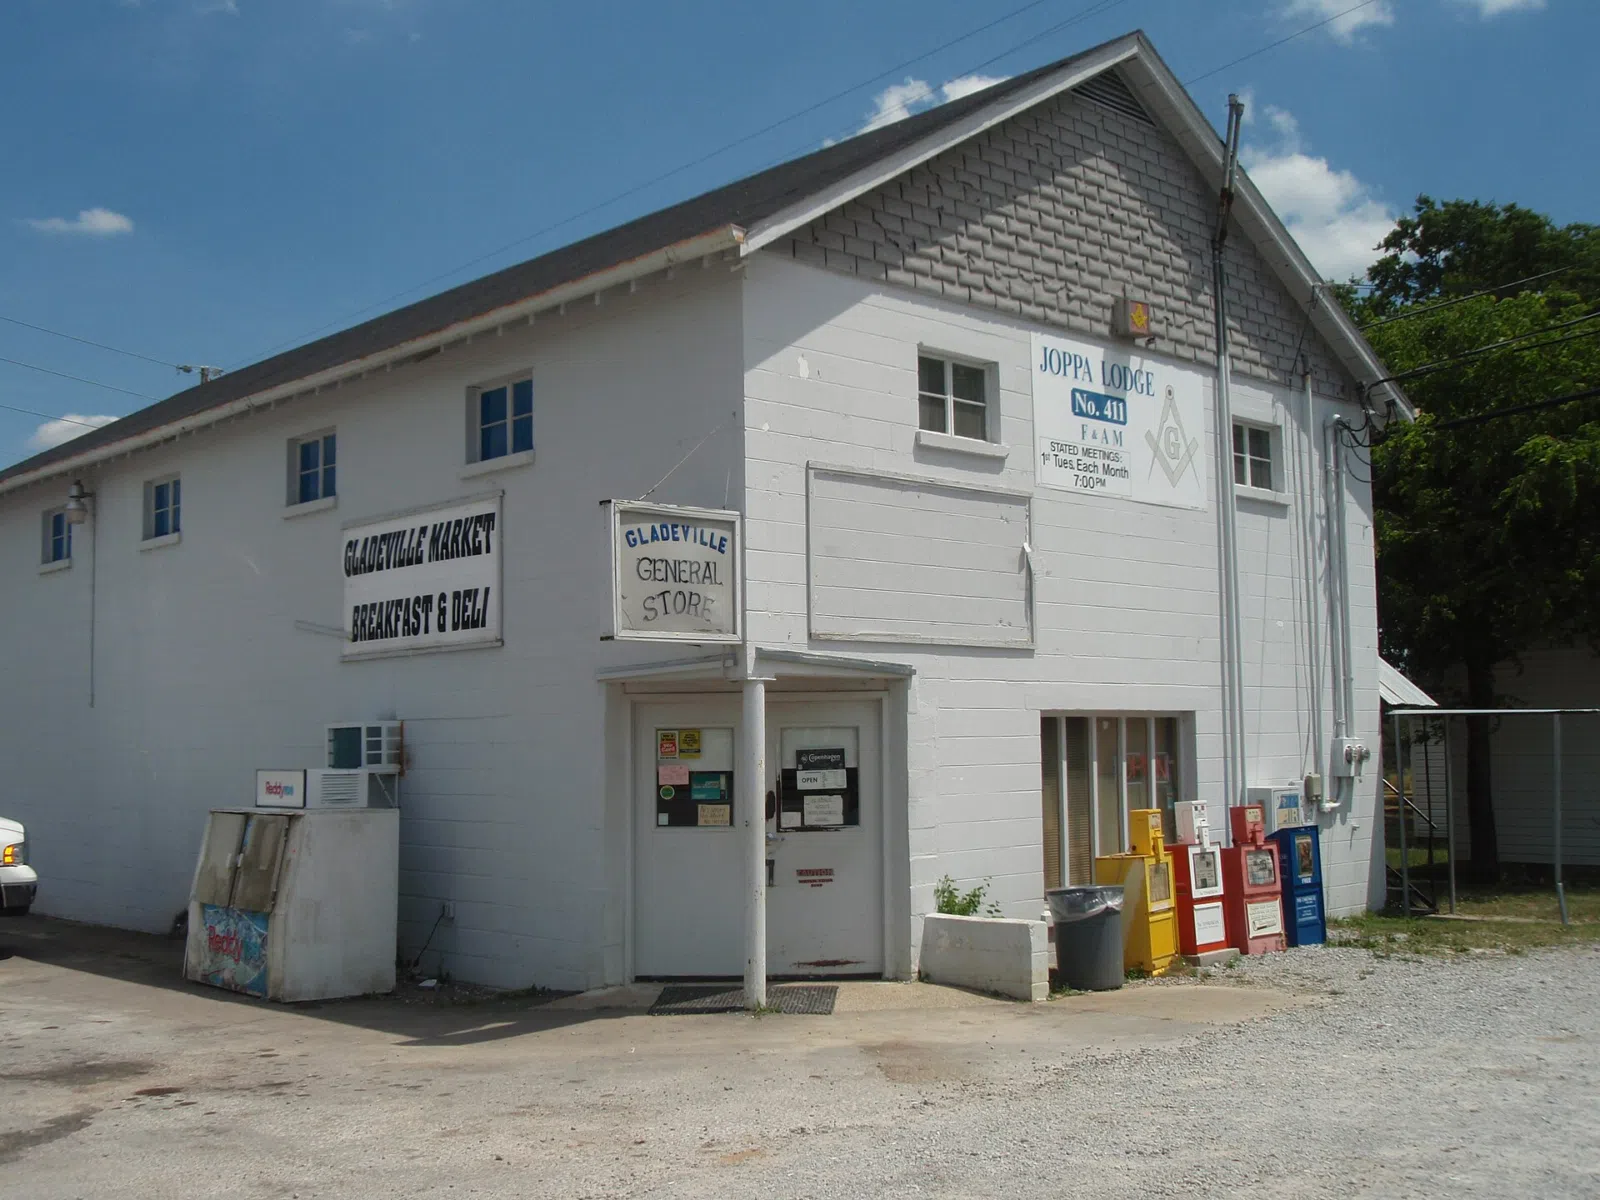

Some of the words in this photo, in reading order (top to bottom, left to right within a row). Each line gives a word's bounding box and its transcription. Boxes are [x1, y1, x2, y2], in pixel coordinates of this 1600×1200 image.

[1040, 346, 1093, 383] JOPPA
[1101, 360, 1155, 397] LODGE
[1075, 392, 1100, 416] No.
[1103, 399, 1125, 421] 411
[1081, 423, 1088, 440] F
[1091, 429, 1098, 440] &
[1101, 428, 1109, 445] A
[1112, 429, 1123, 447] M
[1164, 426, 1181, 460] G
[1041, 452, 1051, 465] 1st
[1076, 458, 1099, 474] Each
[1102, 463, 1129, 479] Month
[1050, 441, 1078, 455] STATED
[1081, 447, 1123, 463] MEETINGS:
[344, 525, 428, 578] GLADEVILLE
[428, 512, 496, 563] MARKET
[625, 523, 728, 554] GLADEVILLE
[636, 557, 723, 586] GENERAL
[351, 594, 433, 642] BREAKFAST
[437, 592, 447, 632] &
[452, 586, 490, 631] DELI
[643, 590, 715, 624] STORE
[808, 753, 841, 763] Copenhagen
